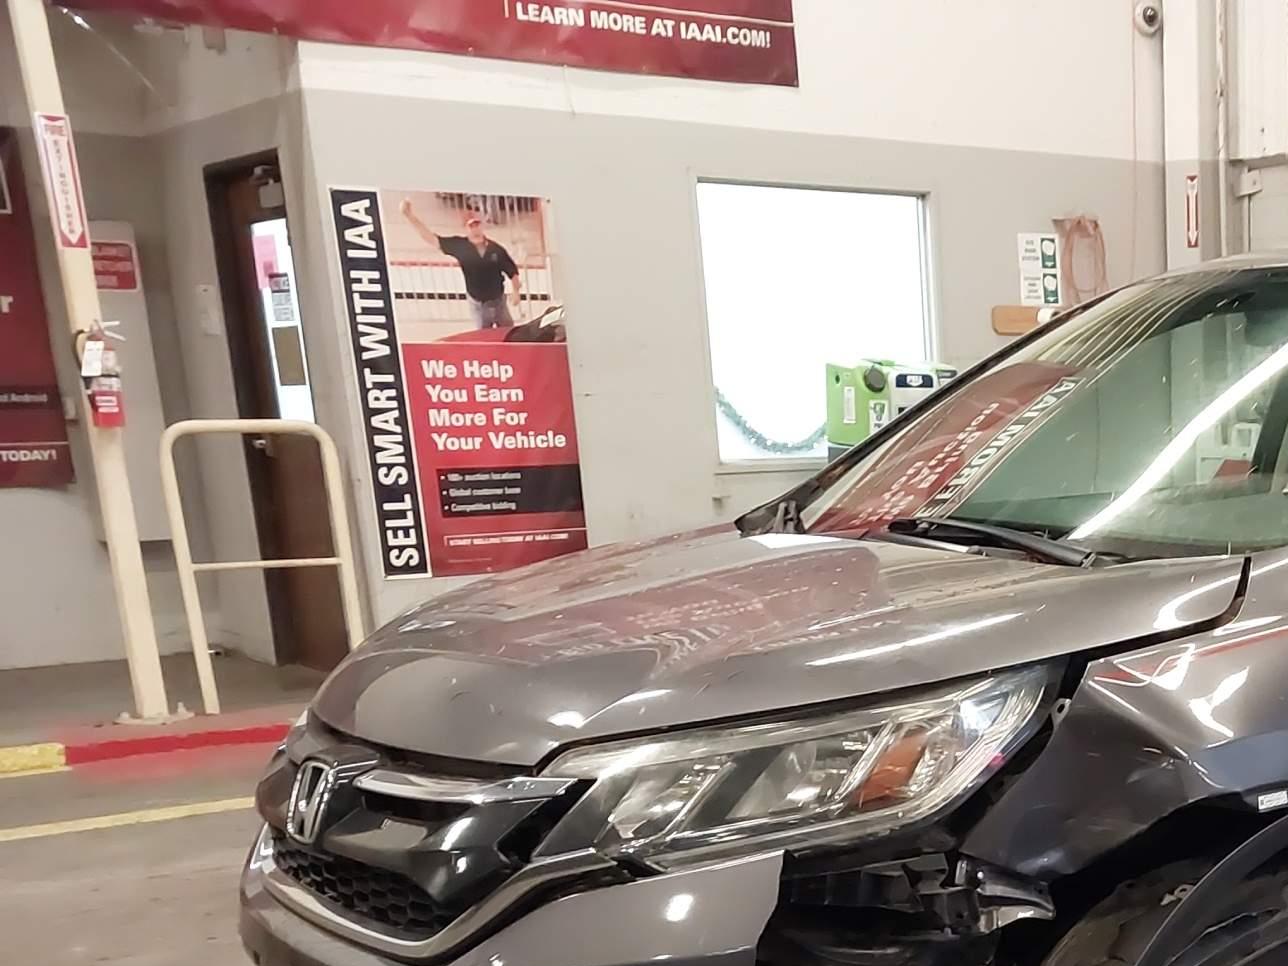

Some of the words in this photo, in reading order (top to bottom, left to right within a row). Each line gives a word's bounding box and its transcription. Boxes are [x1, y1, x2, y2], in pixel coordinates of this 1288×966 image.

[516, 2, 585, 27] LEARN
[590, 11, 647, 35] MORE
[650, 19, 676, 37] AT
[680, 21, 772, 48] IAAI.COM!
[340, 199, 378, 258] IAA
[349, 269, 392, 361] WITH
[421, 360, 457, 379] We
[463, 360, 514, 382] Help
[425, 384, 468, 403] You
[474, 384, 524, 402] Earn
[363, 367, 409, 487] SMART
[428, 408, 487, 427] More
[493, 408, 529, 426] For
[0, 449, 57, 462] TODAY!
[431, 432, 484, 451] Your
[488, 430, 567, 450] Vehicle
[382, 494, 420, 567] SELL
